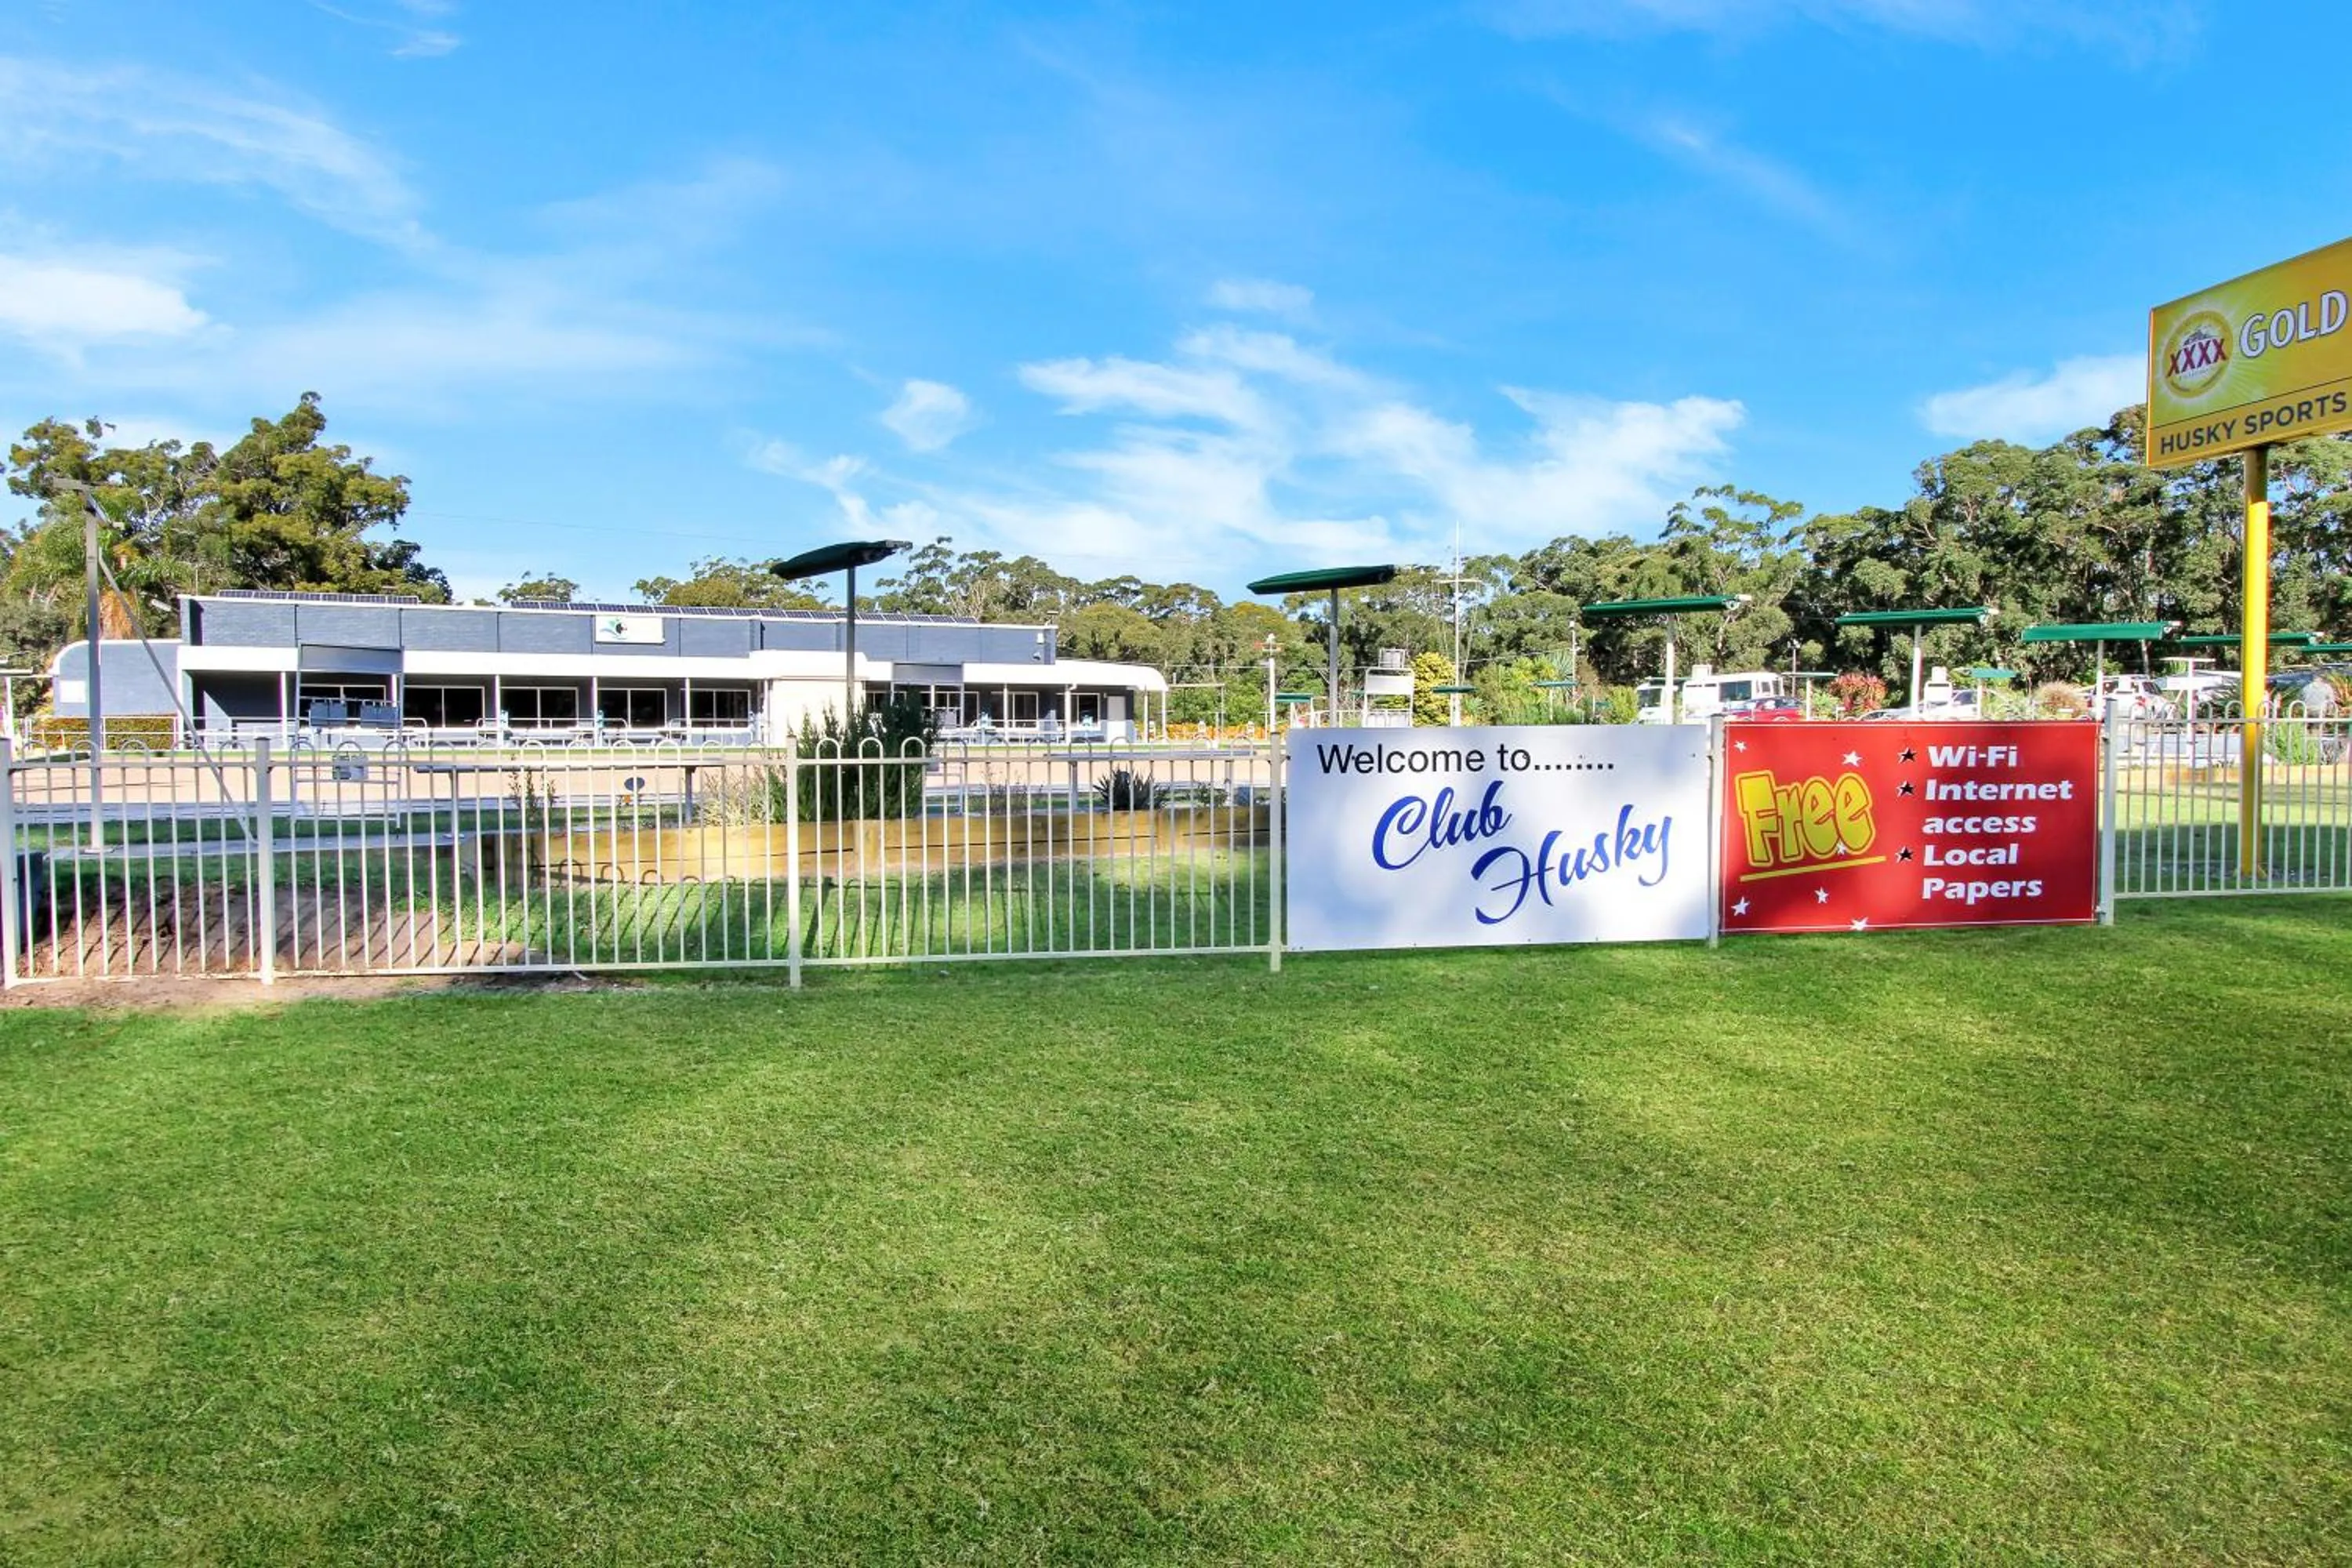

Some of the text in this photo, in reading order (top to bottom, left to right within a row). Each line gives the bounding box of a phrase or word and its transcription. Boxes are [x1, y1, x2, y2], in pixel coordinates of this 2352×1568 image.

[2239, 289, 2348, 359] GOLD
[2166, 338, 2228, 378] XXXX
[2160, 391, 2347, 456] HUSKY SPORTS
[1317, 743, 1485, 774] Welcome
[1928, 745, 2019, 768] Wi-Fi
[1925, 779, 2073, 801] Internet
[1371, 780, 1512, 871] Club
[1734, 769, 1876, 868] Free
[1922, 815, 2038, 835] access
[1470, 804, 1673, 925] Husky
[1923, 844, 2020, 866] Local
[1922, 877, 2043, 905] Papers
